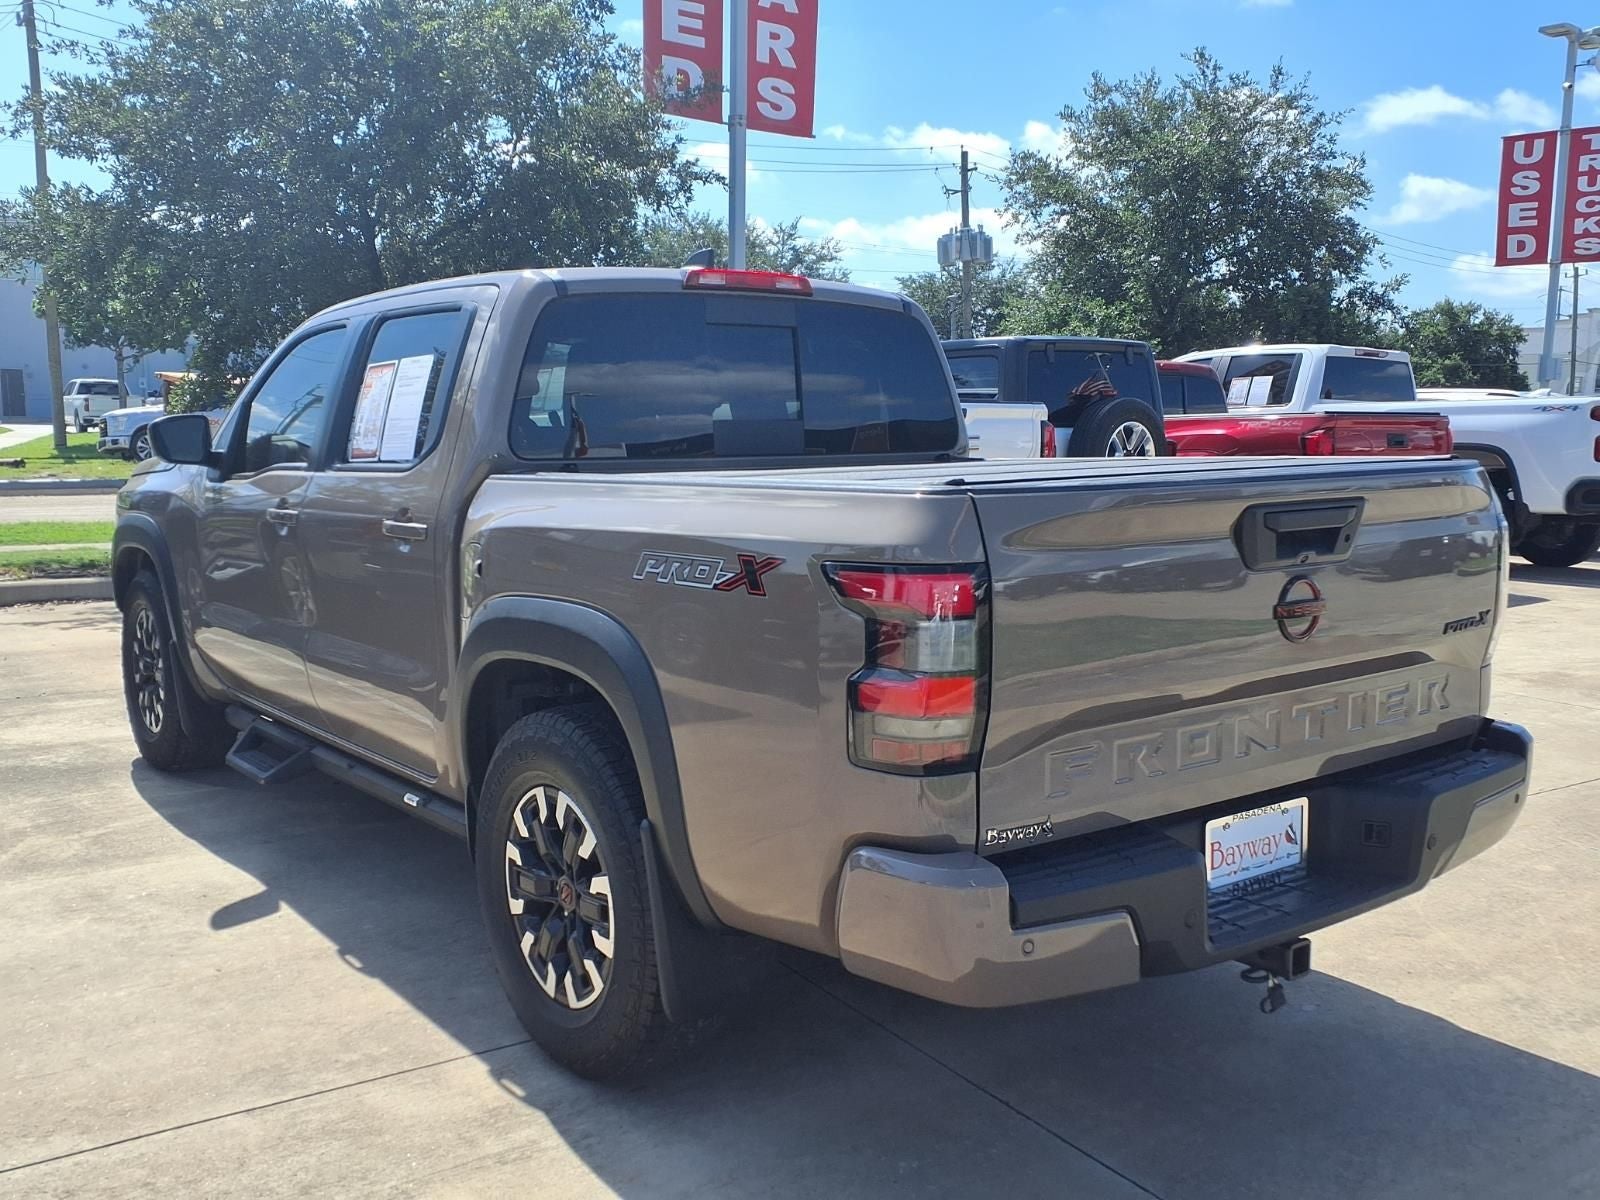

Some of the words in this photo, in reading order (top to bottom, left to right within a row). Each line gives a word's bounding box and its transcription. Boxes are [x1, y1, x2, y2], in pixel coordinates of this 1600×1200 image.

[1506, 138, 1546, 259] USED
[1043, 673, 1451, 799] FRONTIER
[1232, 804, 1282, 822] PASADENA
[984, 823, 1042, 848] Bayway
[1210, 833, 1283, 875] Bayway
